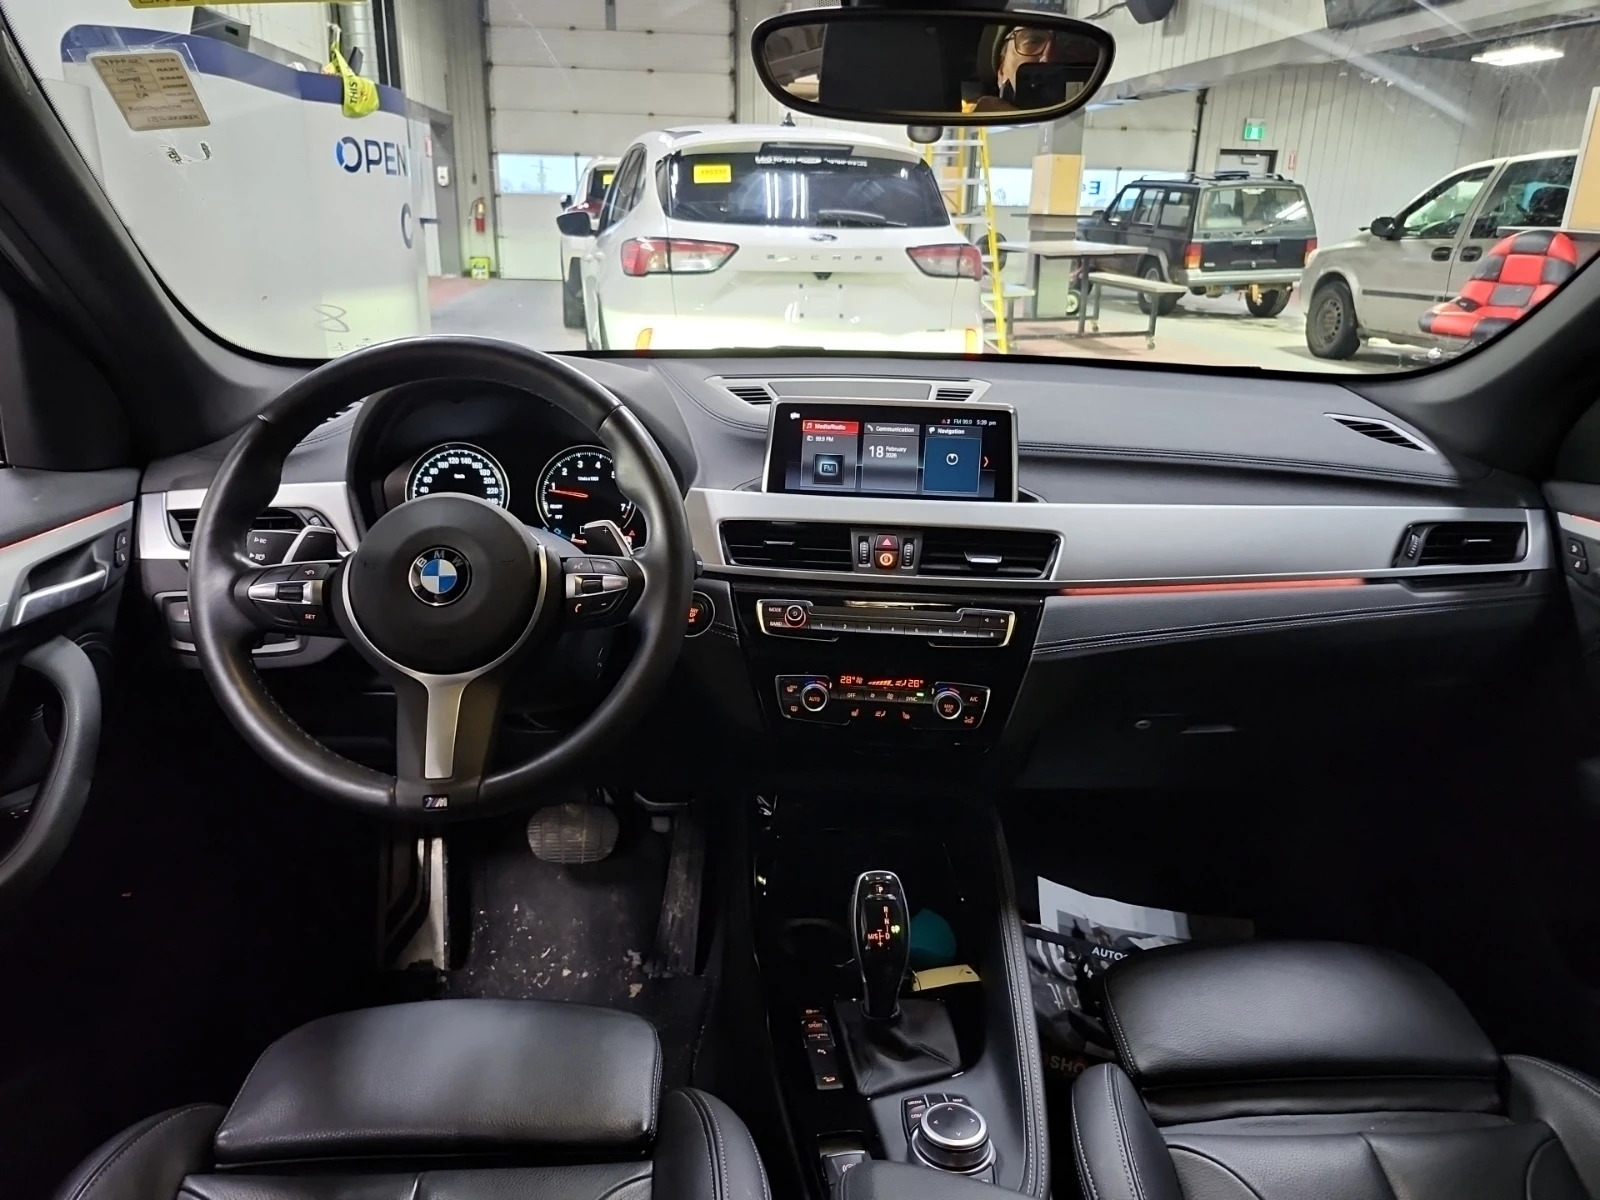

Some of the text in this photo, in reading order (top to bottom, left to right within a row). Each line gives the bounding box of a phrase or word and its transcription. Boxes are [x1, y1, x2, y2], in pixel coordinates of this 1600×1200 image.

[335, 136, 408, 177] OPEN
[814, 423, 847, 431] Media/Radio
[875, 425, 915, 433] Communication
[937, 428, 965, 436] Navigation
[868, 445, 884, 458] 18
[437, 461, 449, 469] 100
[577, 460, 583, 469] 3
[594, 461, 601, 469] 4
[823, 464, 833, 472] FM
[429, 467, 439, 475] 80
[561, 467, 568, 476] 2
[423, 476, 433, 484] 60
[483, 477, 496, 485] 200
[420, 486, 429, 494] 40
[486, 487, 499, 495] 220
[620, 503, 626, 512] 7
[416, 549, 464, 568] BMW
